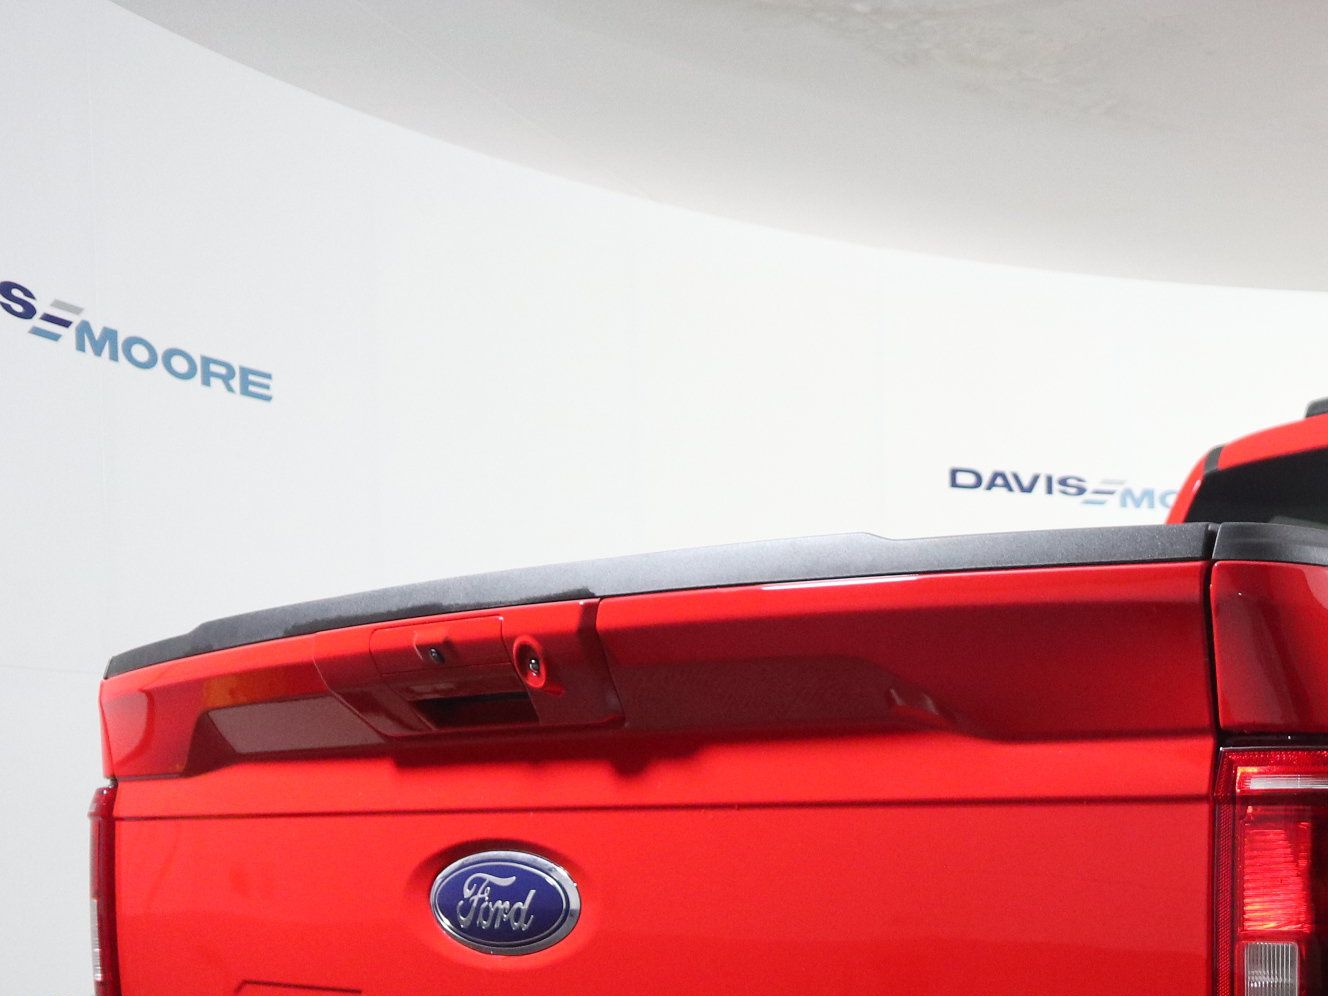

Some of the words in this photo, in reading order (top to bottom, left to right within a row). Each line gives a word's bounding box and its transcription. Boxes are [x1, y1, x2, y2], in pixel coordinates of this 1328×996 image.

[75, 319, 273, 402] MOORE
[949, 467, 1088, 496] DAVIS
[456, 872, 537, 932] Ford
